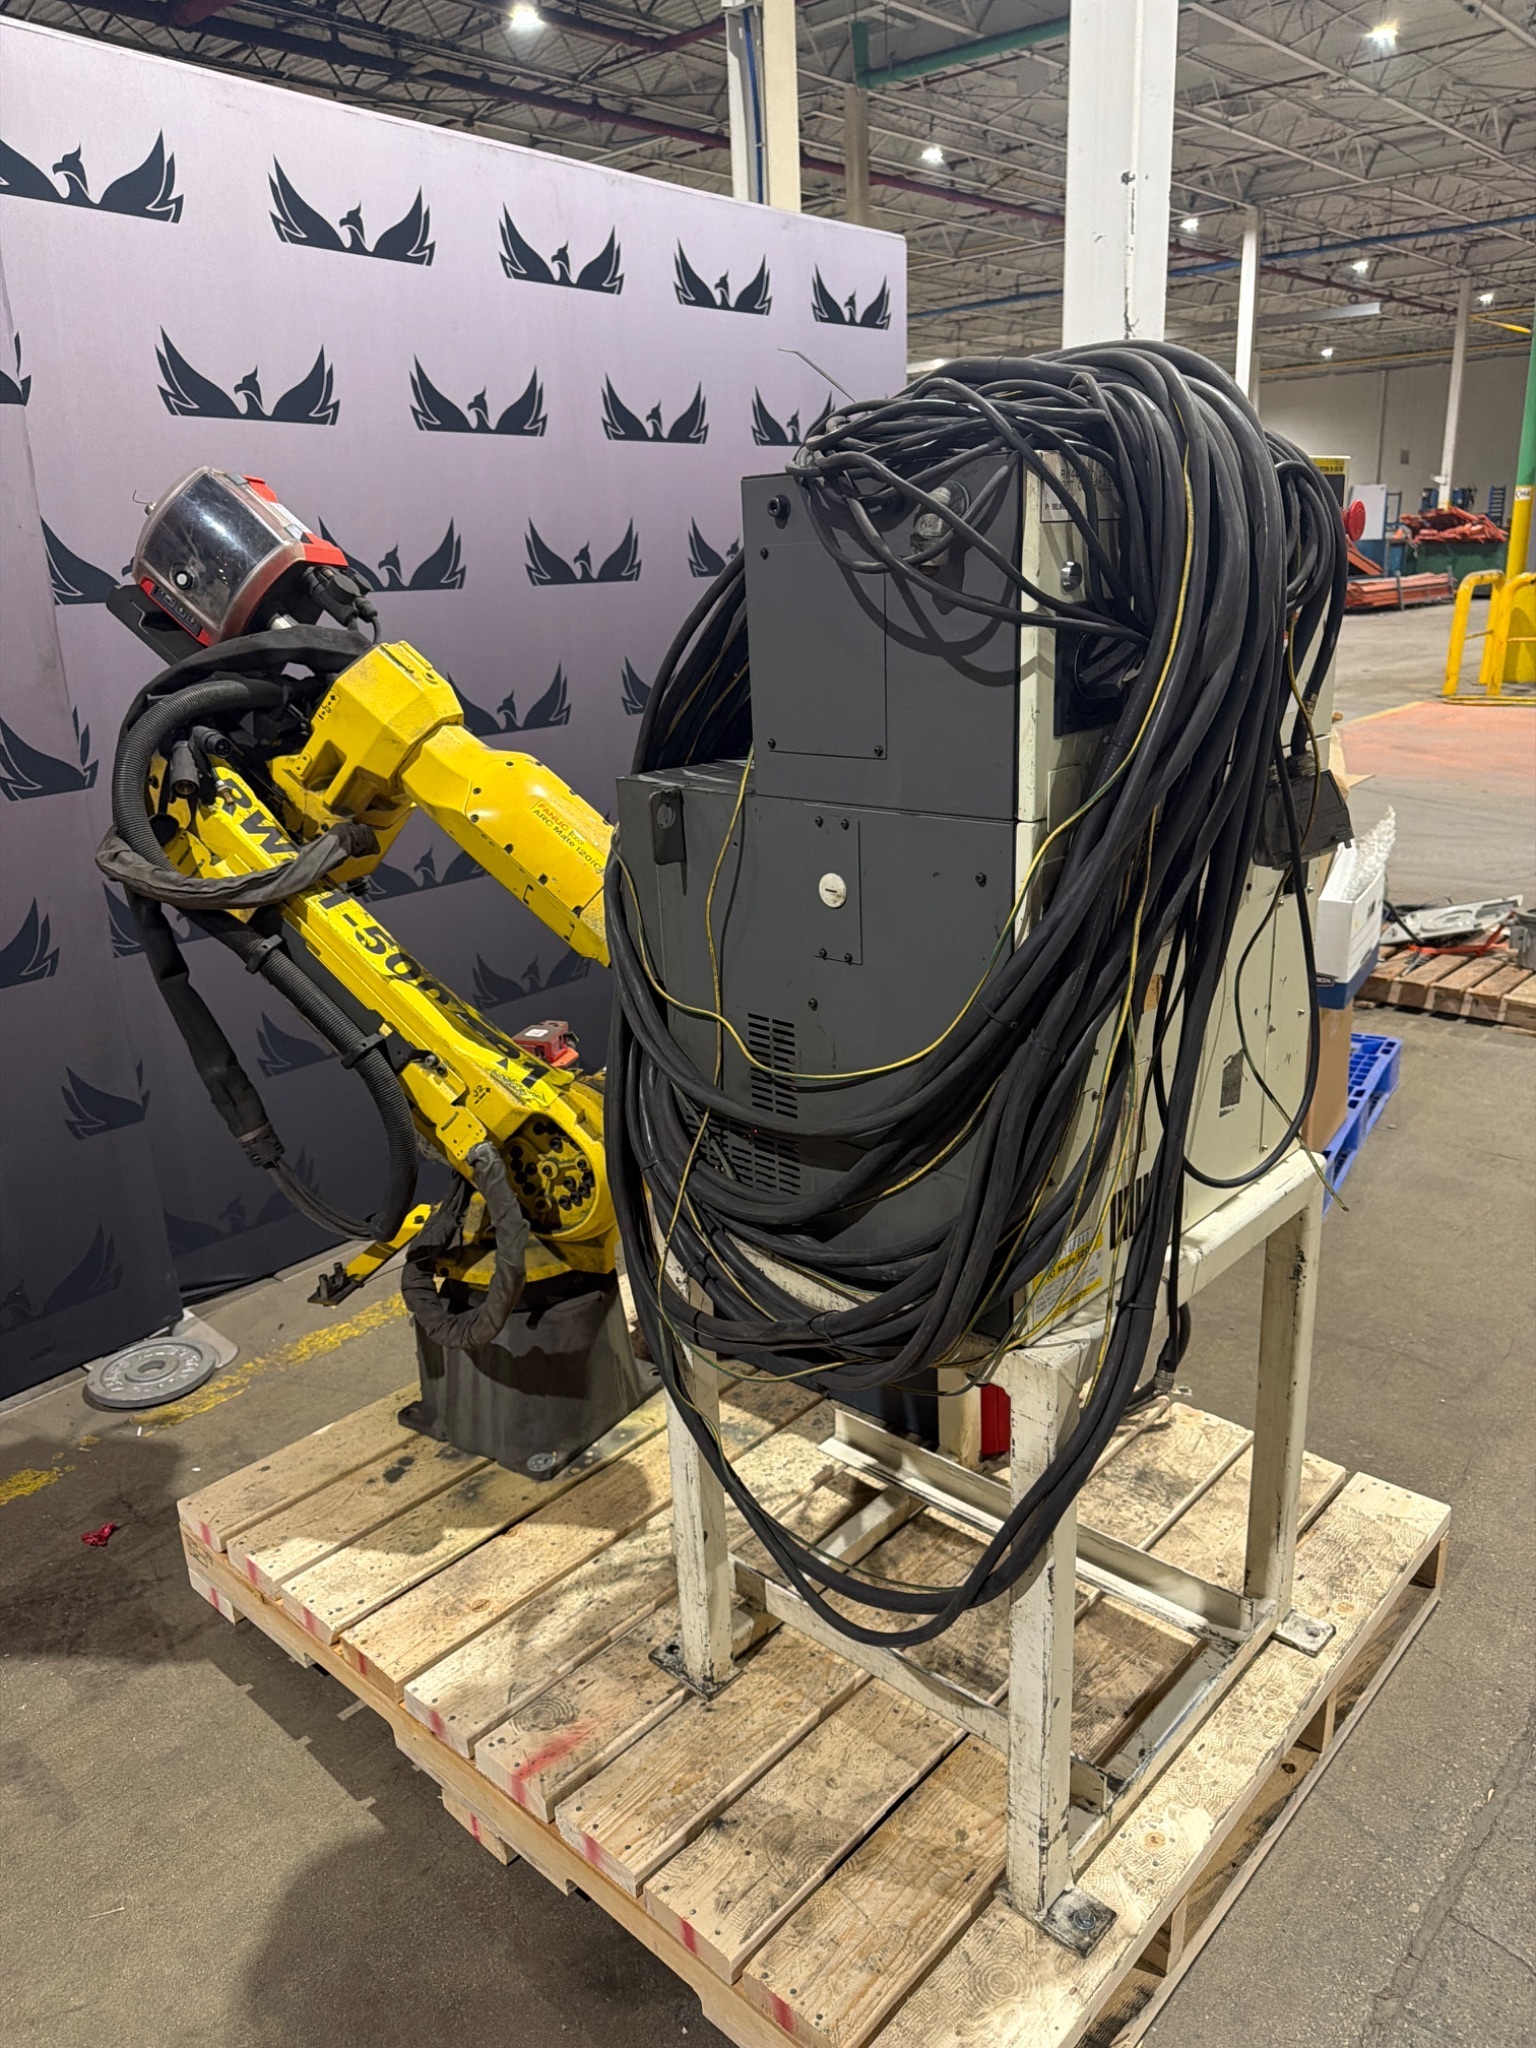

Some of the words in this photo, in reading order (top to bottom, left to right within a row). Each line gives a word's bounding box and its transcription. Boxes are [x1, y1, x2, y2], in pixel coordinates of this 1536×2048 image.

[533, 809, 554, 828] ARC
[553, 826, 575, 847] Mate
[538, 803, 569, 831] FANUC
